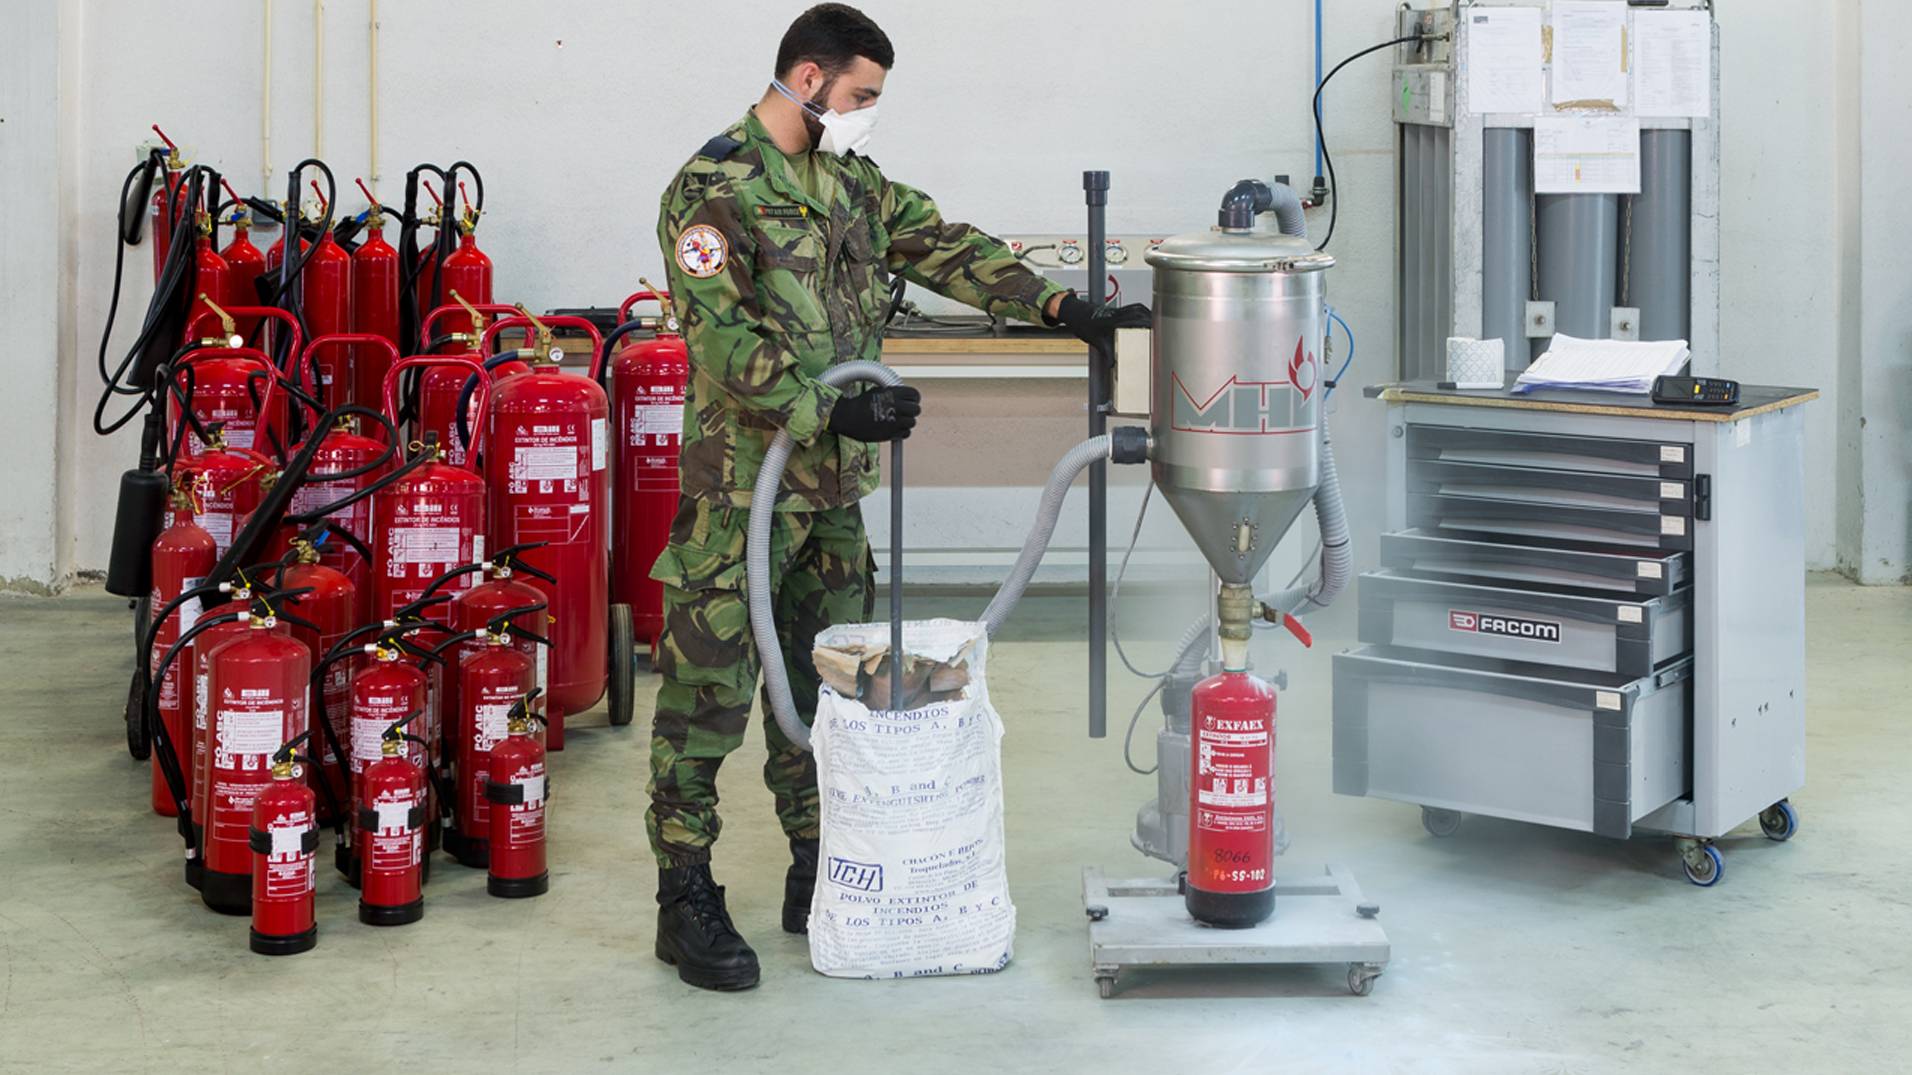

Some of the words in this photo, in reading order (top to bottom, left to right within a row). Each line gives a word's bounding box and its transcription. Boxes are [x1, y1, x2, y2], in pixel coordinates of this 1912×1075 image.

[1480, 618, 1557, 639] FACOM
[216, 710, 224, 744] ABC
[475, 704, 484, 730] ABC
[1216, 719, 1265, 731] EXFAEX
[875, 722, 921, 736] TIPOS
[474, 736, 483, 752] PÓ
[214, 747, 223, 768] PÓ
[910, 780, 936, 790] and
[1214, 848, 1251, 864] 8066
[830, 858, 877, 891] TCH
[840, 892, 881, 904] POLVO
[889, 890, 956, 904] EXTINTOR
[964, 880, 978, 892] DE
[846, 916, 870, 928] LOS
[880, 916, 924, 927] TIPOS
[991, 896, 1000, 906] C
[874, 902, 948, 915] INCENDIOS
